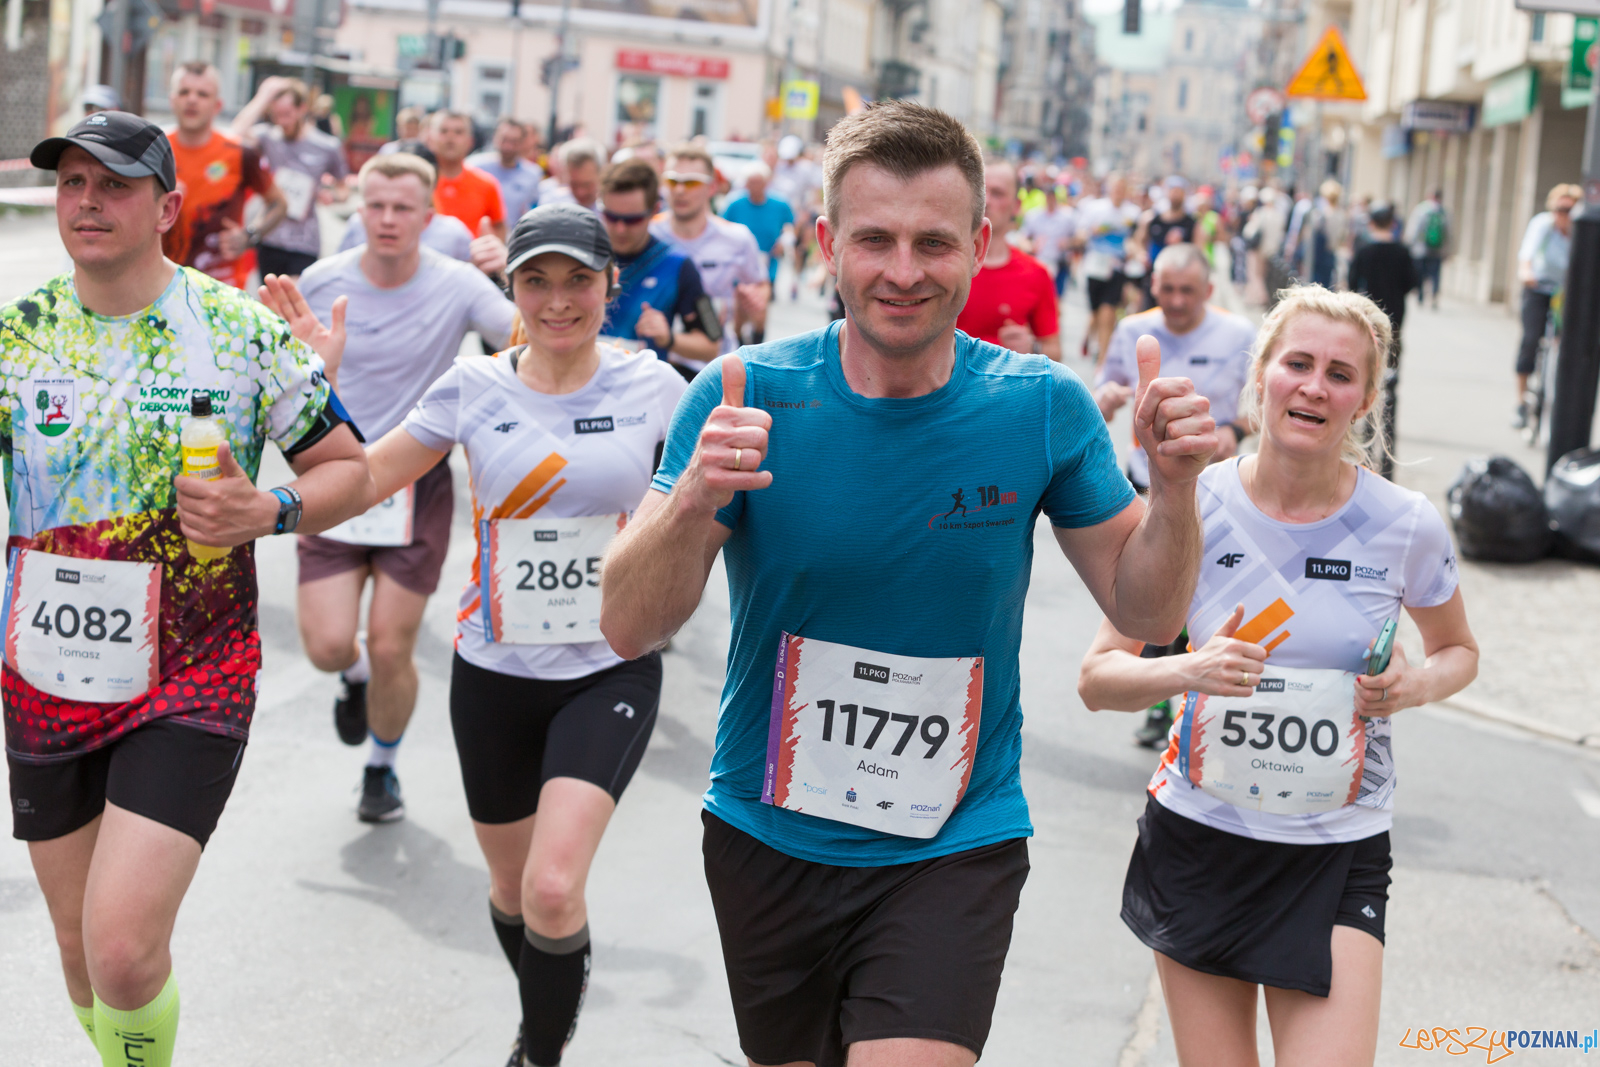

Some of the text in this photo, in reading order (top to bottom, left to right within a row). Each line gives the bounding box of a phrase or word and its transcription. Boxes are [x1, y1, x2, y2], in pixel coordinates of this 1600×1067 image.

[140, 386, 148, 399] 4
[150, 387, 189, 400] PORY
[763, 396, 806, 409] luanvi
[590, 419, 612, 431] PKO
[200, 465, 223, 479] JUNIO
[939, 522, 949, 530] 10
[949, 521, 962, 530] km
[963, 521, 985, 530] Szpot
[1215, 552, 1246, 569] 4F
[64, 571, 79, 580] PKO
[516, 556, 603, 591] 2865
[1311, 562, 1348, 576] 11. PKO
[546, 596, 577, 608] ANNA
[31, 600, 133, 643] 4082
[57, 645, 101, 660] Tomasz
[777, 670, 785, 679] D
[858, 666, 887, 679] 11. PKO
[1267, 681, 1284, 689] PKO
[816, 698, 950, 760] 11779
[1220, 709, 1340, 757] 5300
[856, 759, 899, 780] Adam
[1250, 758, 1304, 774] Oktawia
[876, 800, 895, 810] 4F
